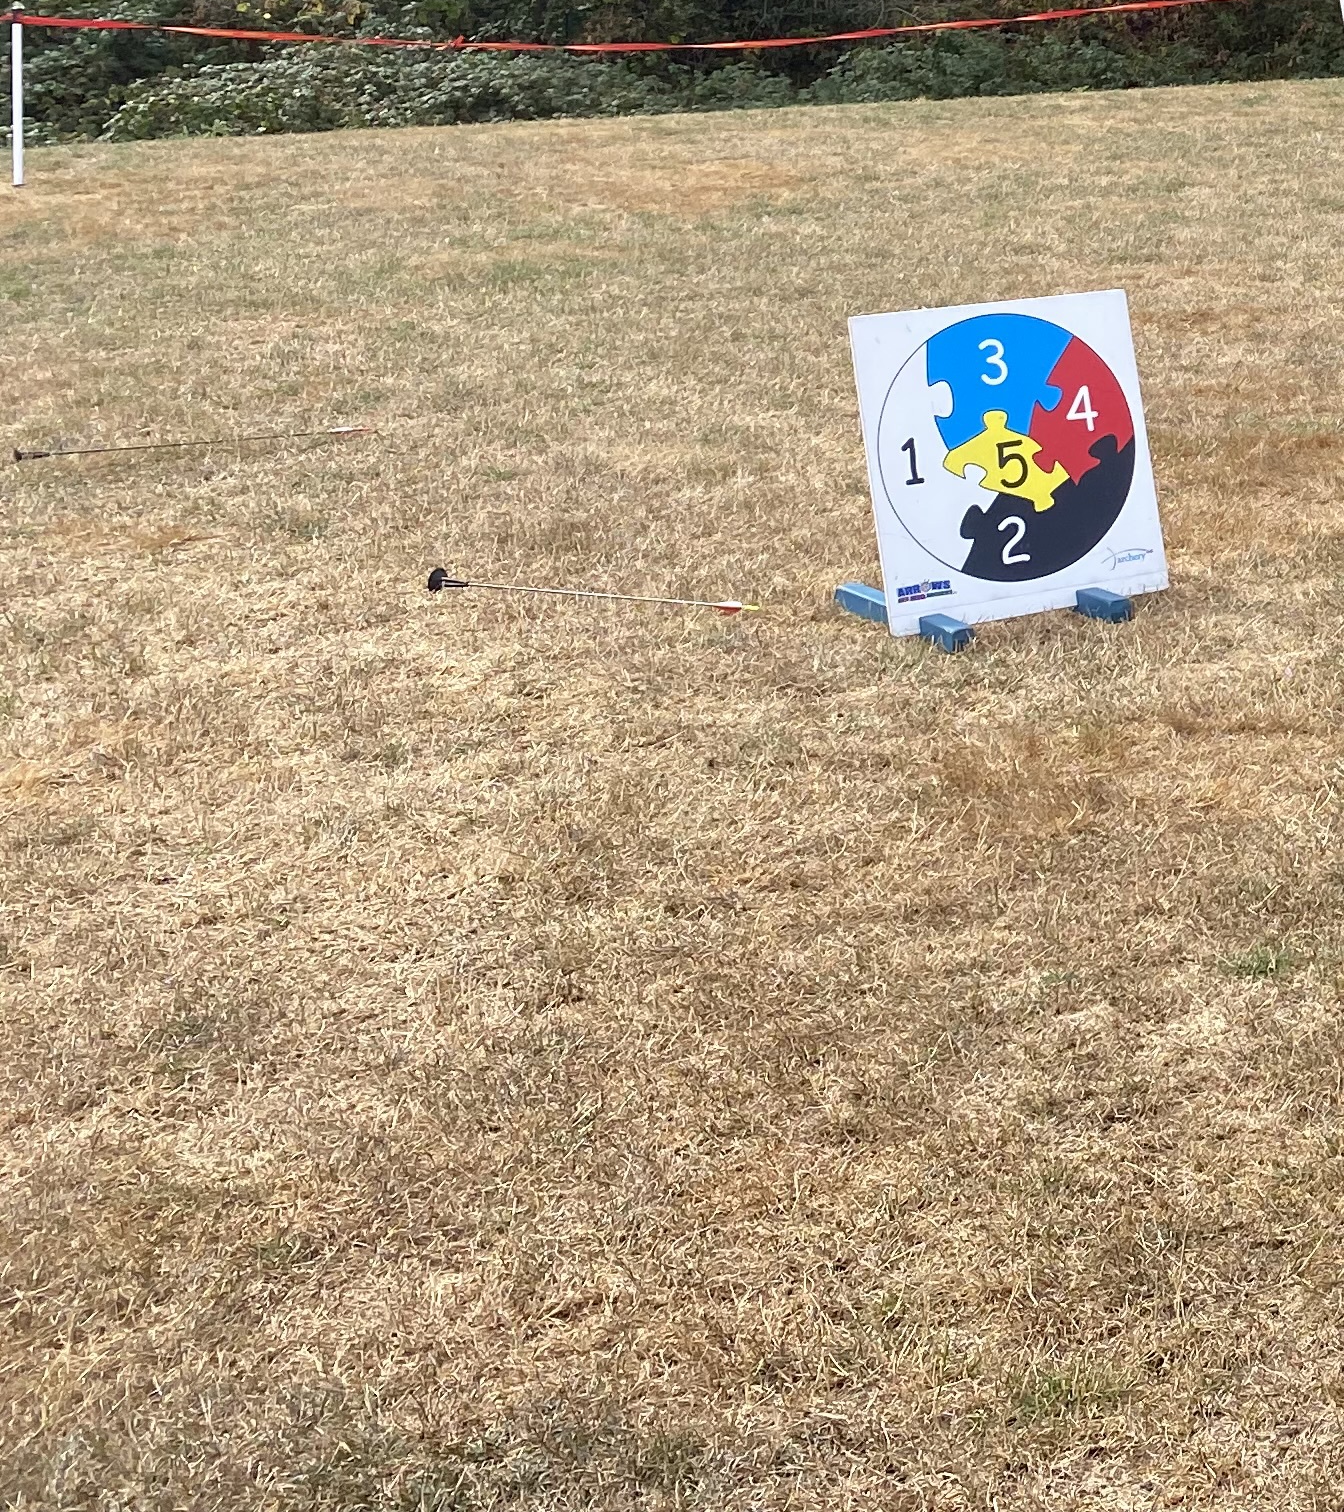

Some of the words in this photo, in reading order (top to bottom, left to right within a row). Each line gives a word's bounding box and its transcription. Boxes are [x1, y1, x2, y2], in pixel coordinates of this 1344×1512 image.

[978, 339, 1008, 385] 3
[1066, 385, 1099, 431] 4
[901, 438, 925, 485] 1
[996, 440, 1028, 488] 5
[998, 516, 1031, 565] 2
